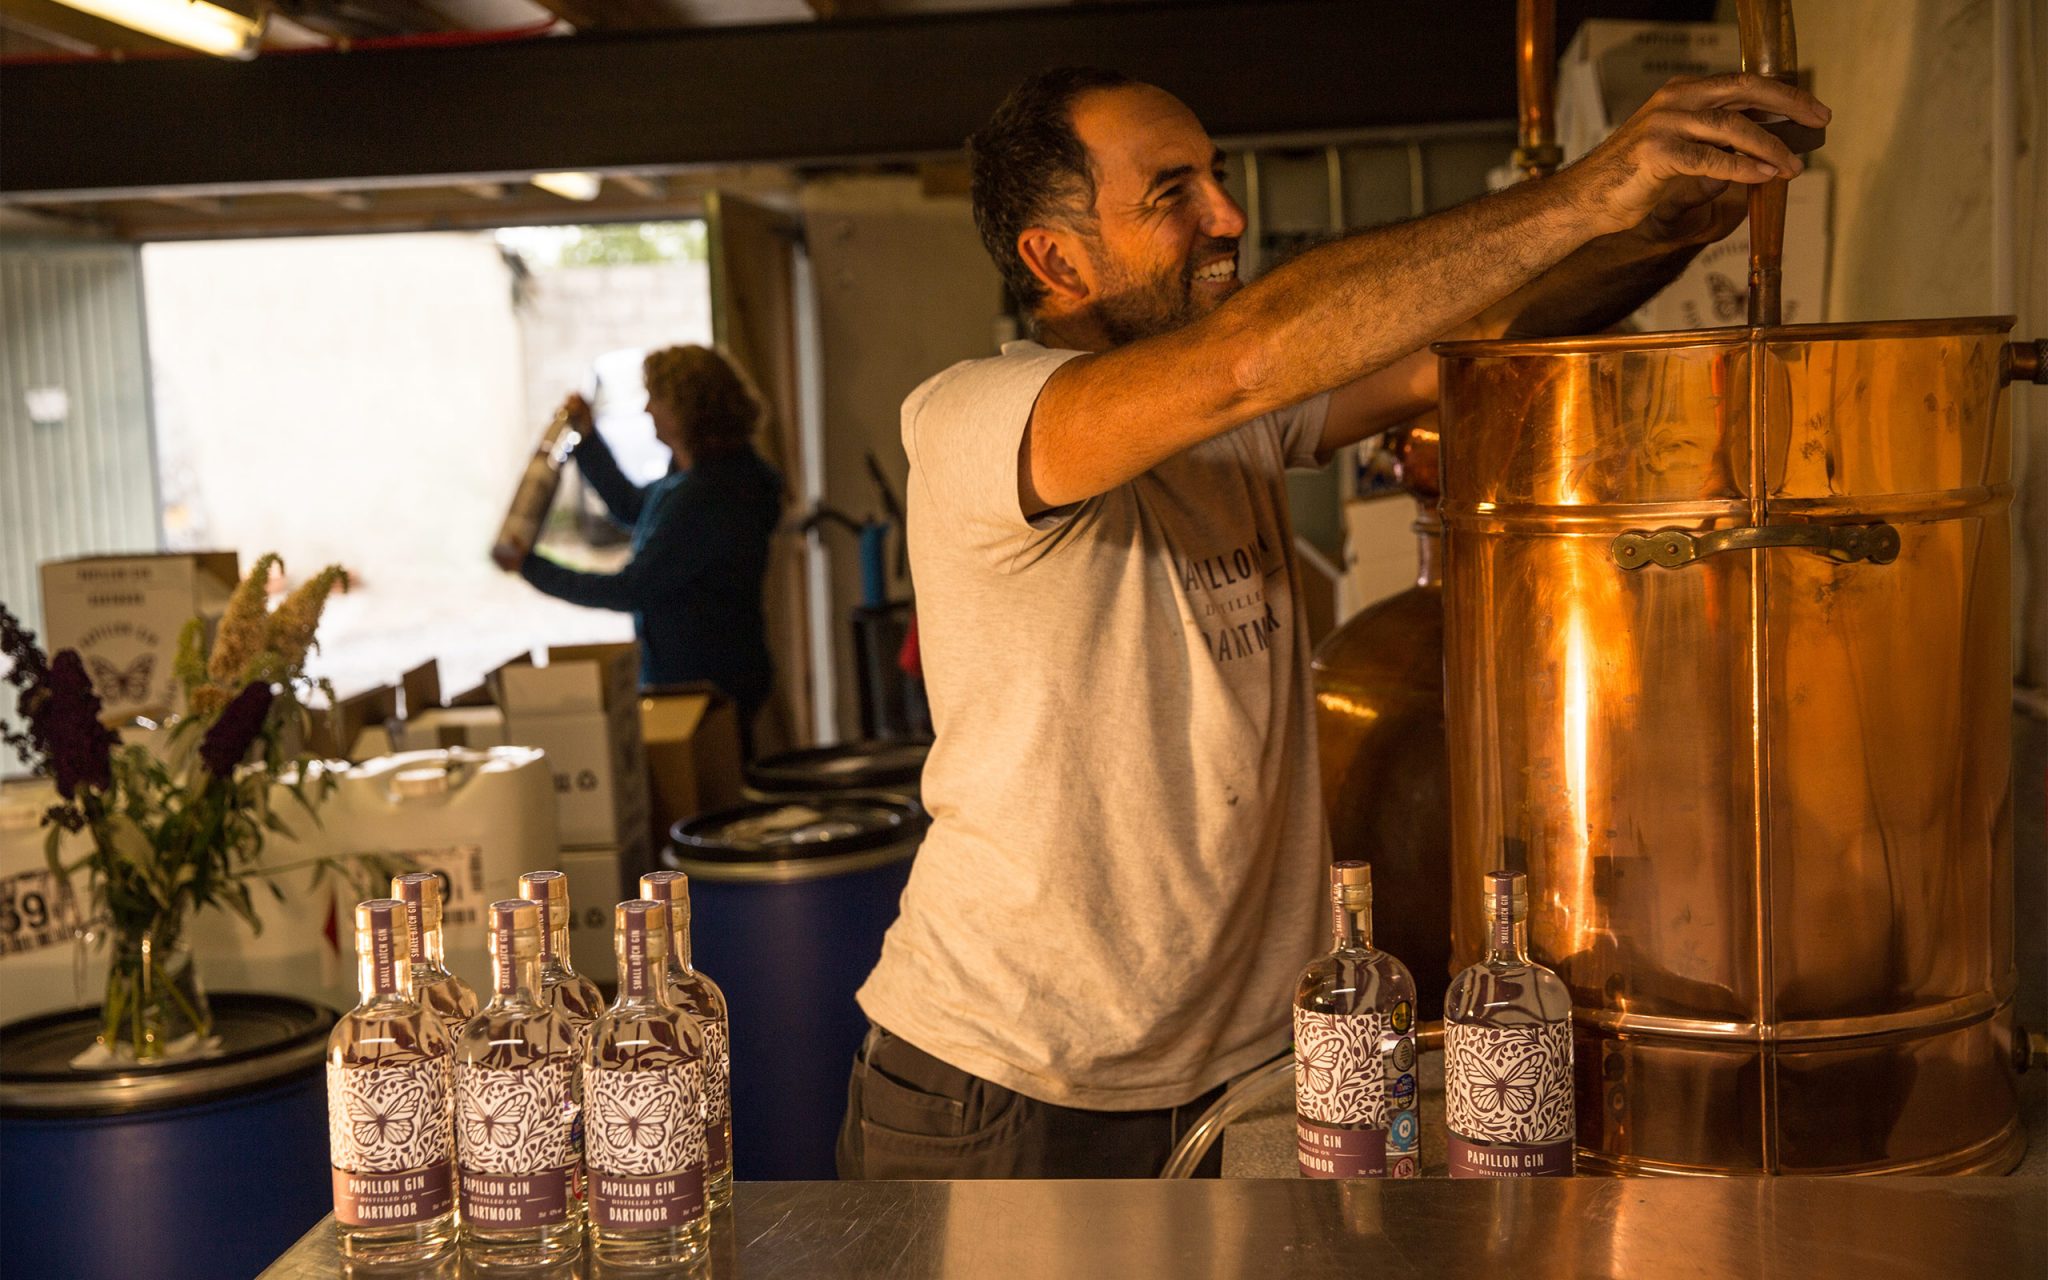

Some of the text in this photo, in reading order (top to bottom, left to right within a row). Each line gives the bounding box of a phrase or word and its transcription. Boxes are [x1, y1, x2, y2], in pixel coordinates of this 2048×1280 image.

[408, 901, 416, 914] GIN
[1500, 895, 1508, 906] GIN
[499, 929, 508, 942] GIN
[631, 930, 640, 943] GIN
[1501, 926, 1509, 944] SMALL
[410, 937, 420, 958] SMALL
[378, 928, 390, 988] SMALL BATCH GIN
[502, 966, 510, 989] SMALL
[632, 968, 642, 990] SMALL
[1323, 1134, 1342, 1148] GIN
[1467, 1150, 1544, 1168] PAPILLON GIN
[1479, 1168, 1518, 1178] DISTILLED
[349, 1176, 424, 1194] PAPILLON GIN
[463, 1176, 530, 1196] PAPILLON GIN
[601, 1180, 676, 1198] PAPILLON GIN
[358, 1202, 418, 1220] DARTMOOR
[468, 1202, 522, 1221] DARTMOOR
[609, 1206, 668, 1222] DARTMOOR
